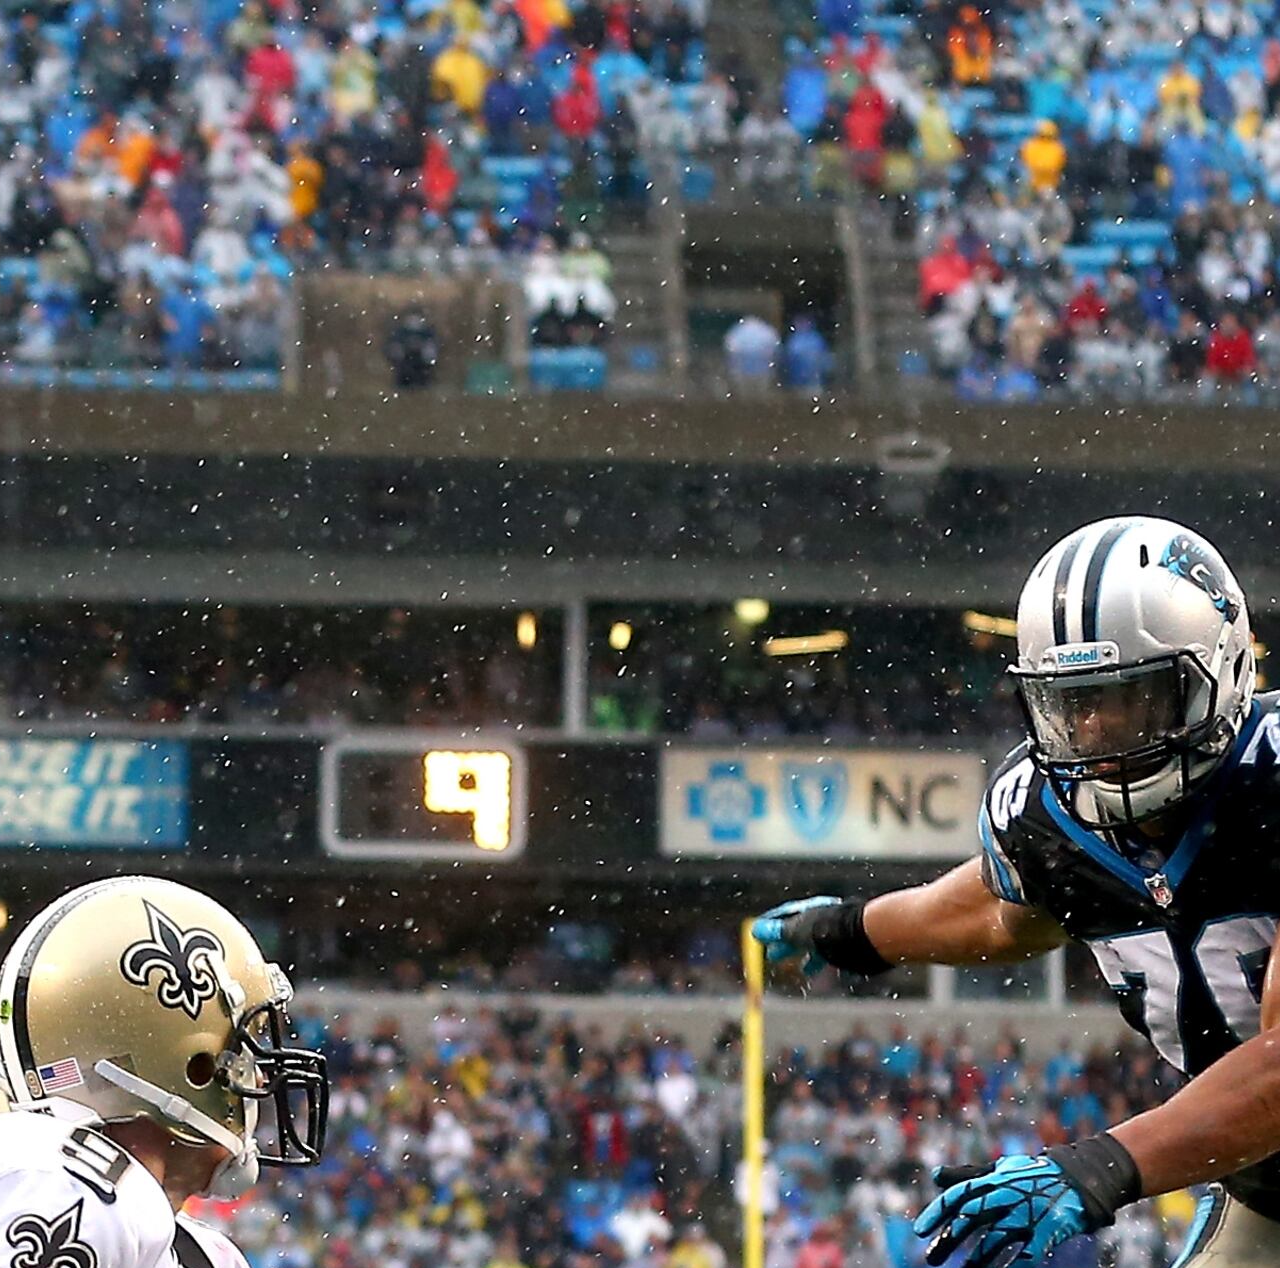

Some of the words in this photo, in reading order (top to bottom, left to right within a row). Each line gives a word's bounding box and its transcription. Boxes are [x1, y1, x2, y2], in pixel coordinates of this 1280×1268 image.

[1057, 646, 1098, 664] Riddell
[81, 738, 141, 783] IT
[423, 749, 512, 850] 9
[867, 772, 960, 833] NC
